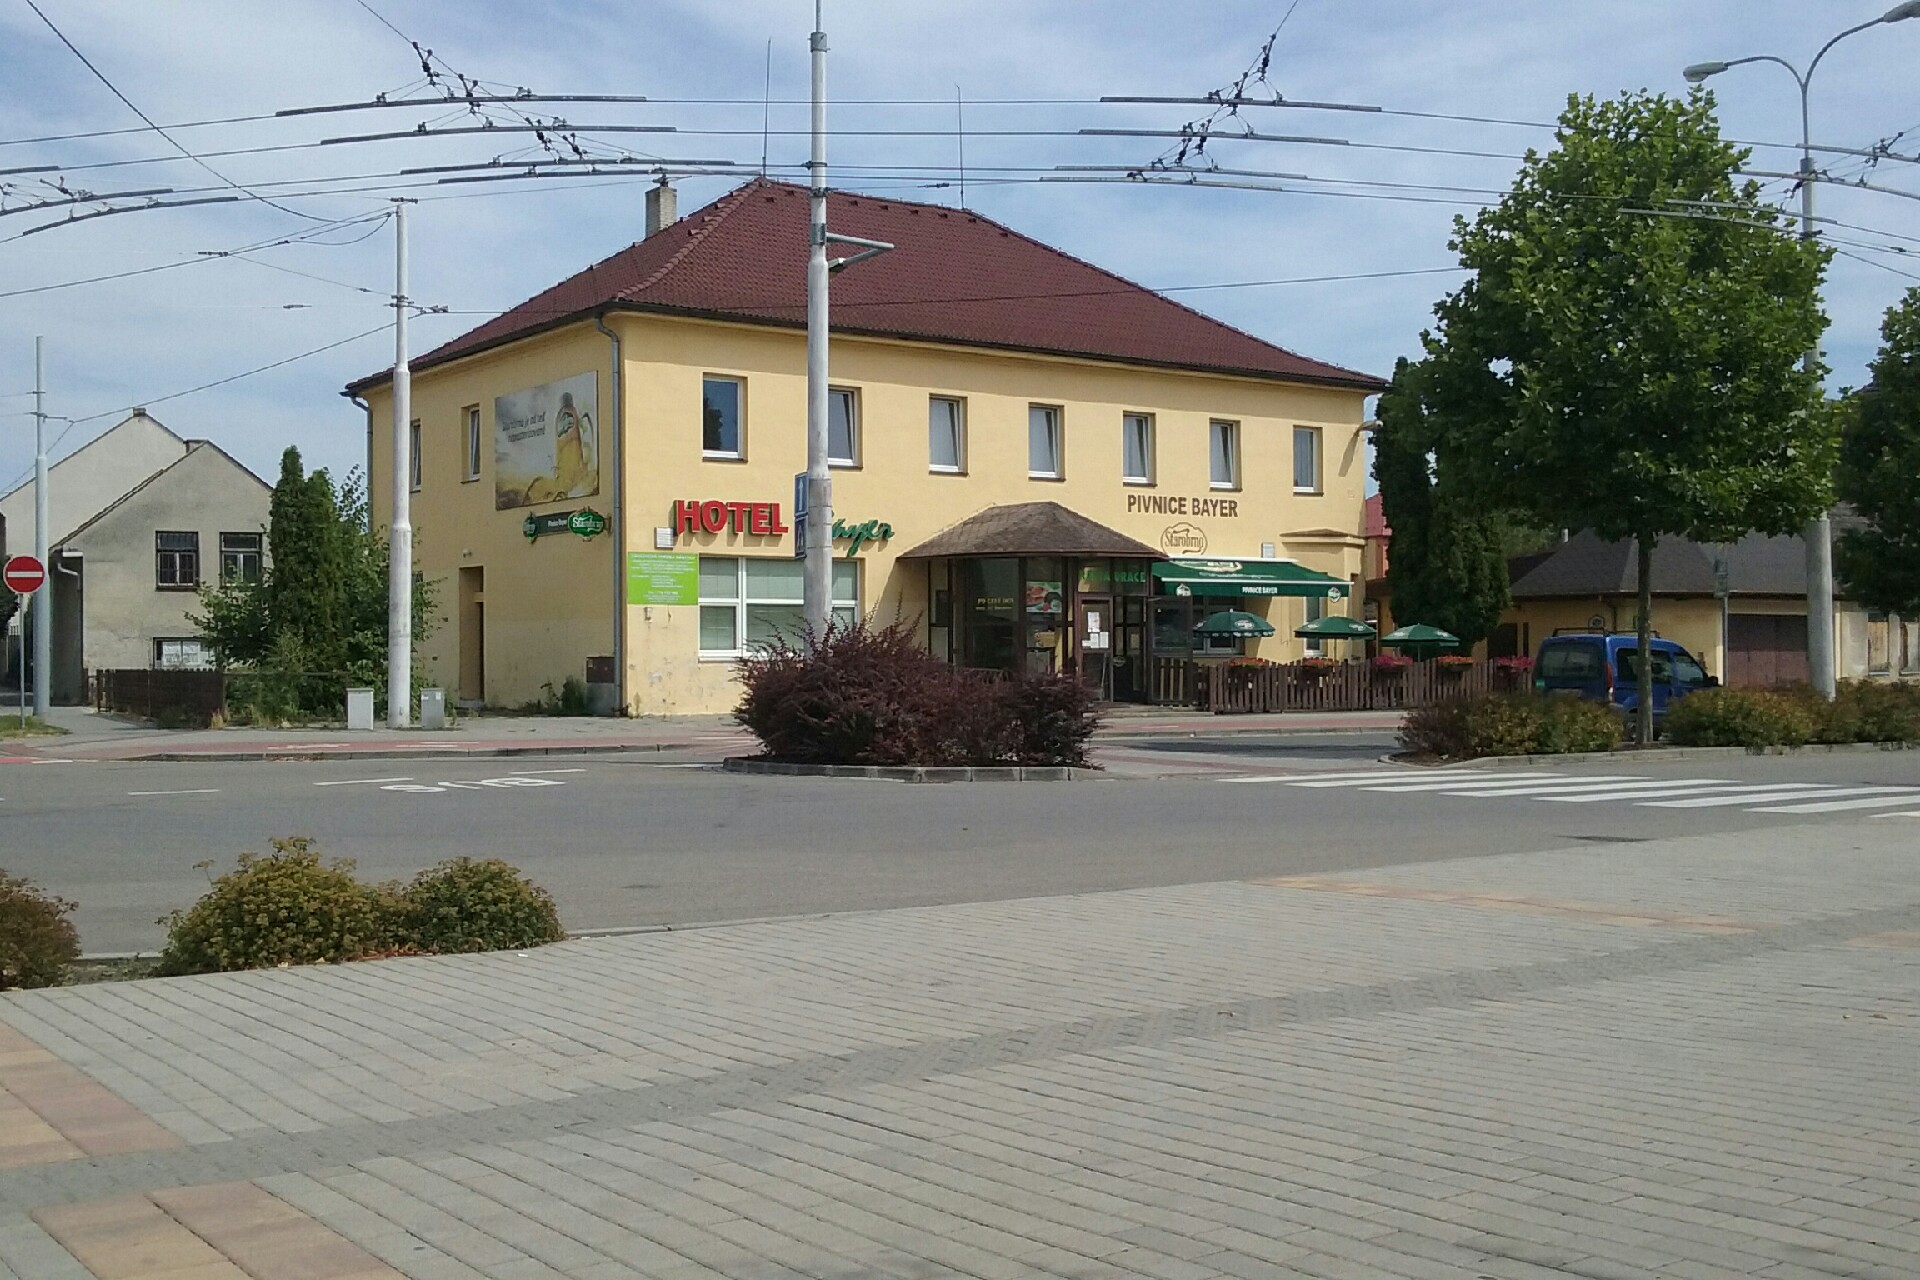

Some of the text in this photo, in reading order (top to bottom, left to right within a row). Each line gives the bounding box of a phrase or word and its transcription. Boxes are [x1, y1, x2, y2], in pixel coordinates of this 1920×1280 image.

[673, 499, 789, 535] HOTEL
[1127, 494, 1239, 518] PIVNICE BAYER
